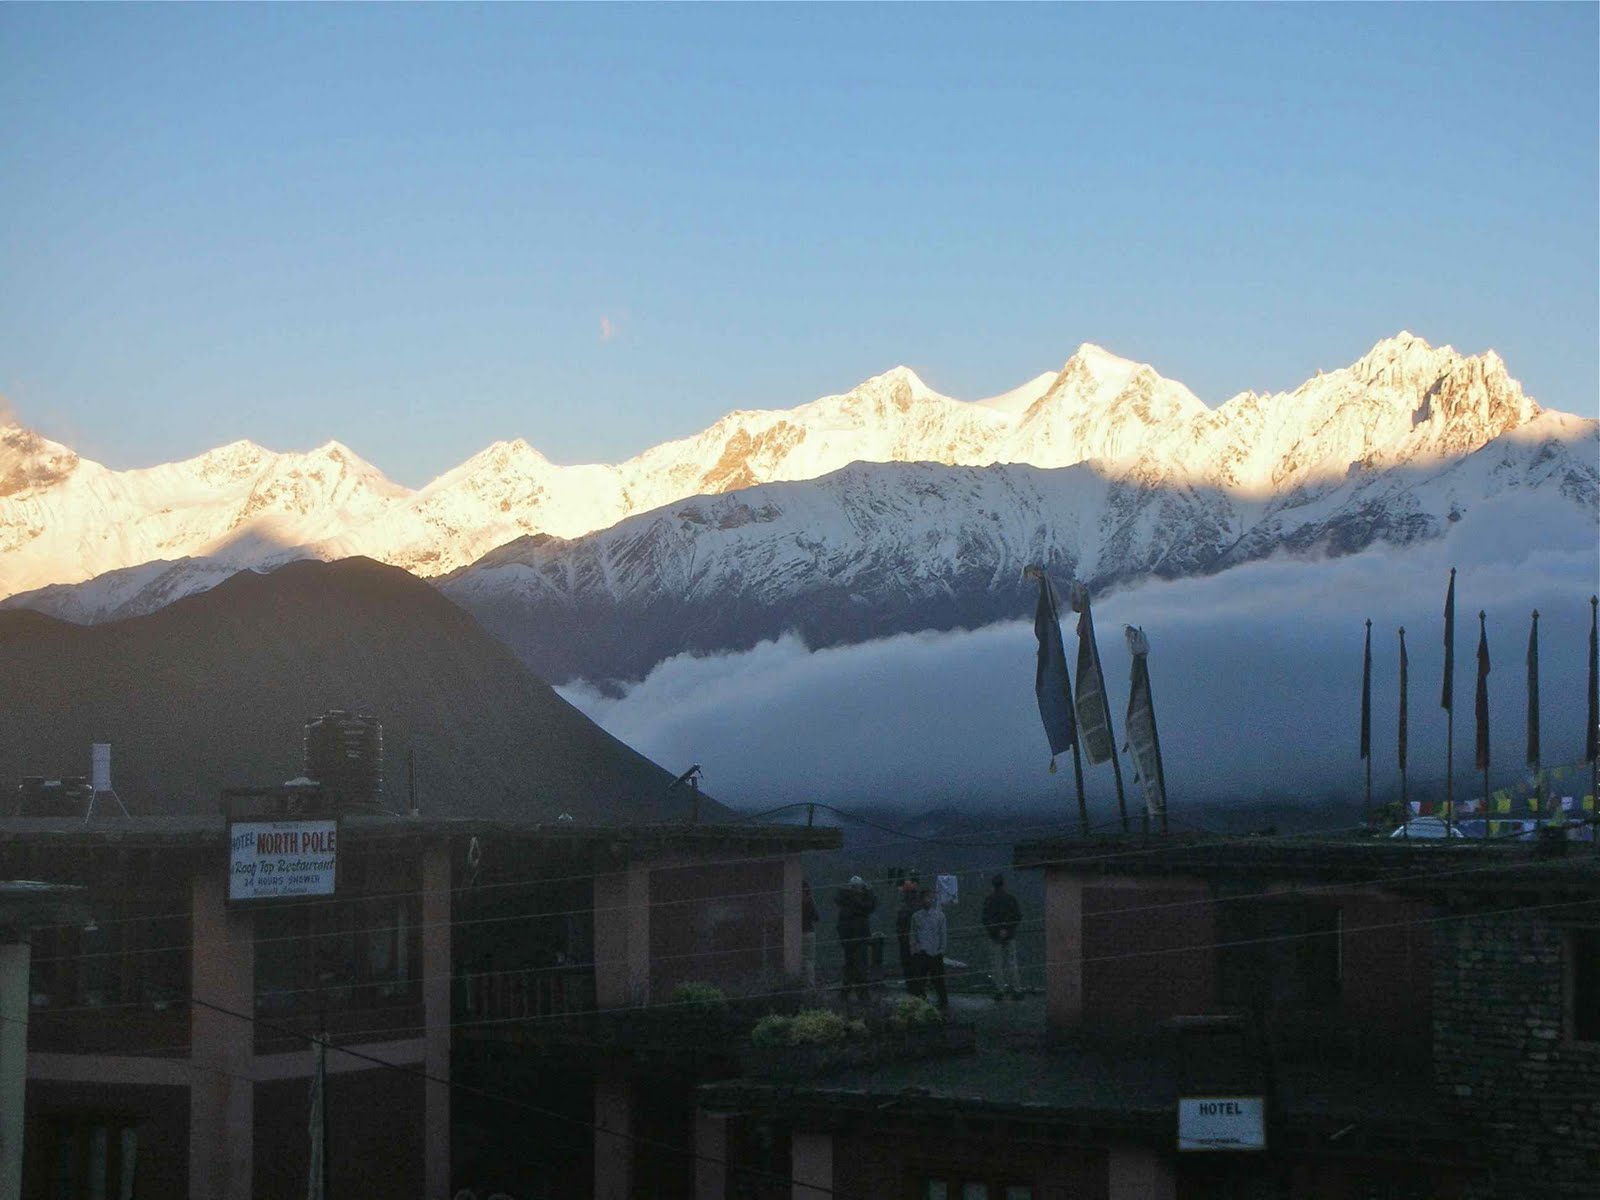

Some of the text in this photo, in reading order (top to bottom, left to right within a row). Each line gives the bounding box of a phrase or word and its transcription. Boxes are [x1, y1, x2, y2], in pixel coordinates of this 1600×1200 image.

[232, 831, 336, 854] HOTEL NORTH POLE
[260, 860, 274, 874] Top
[278, 857, 335, 873] Restaurant
[288, 874, 321, 885] SHOWER
[1199, 1102, 1243, 1115] HOTEL
